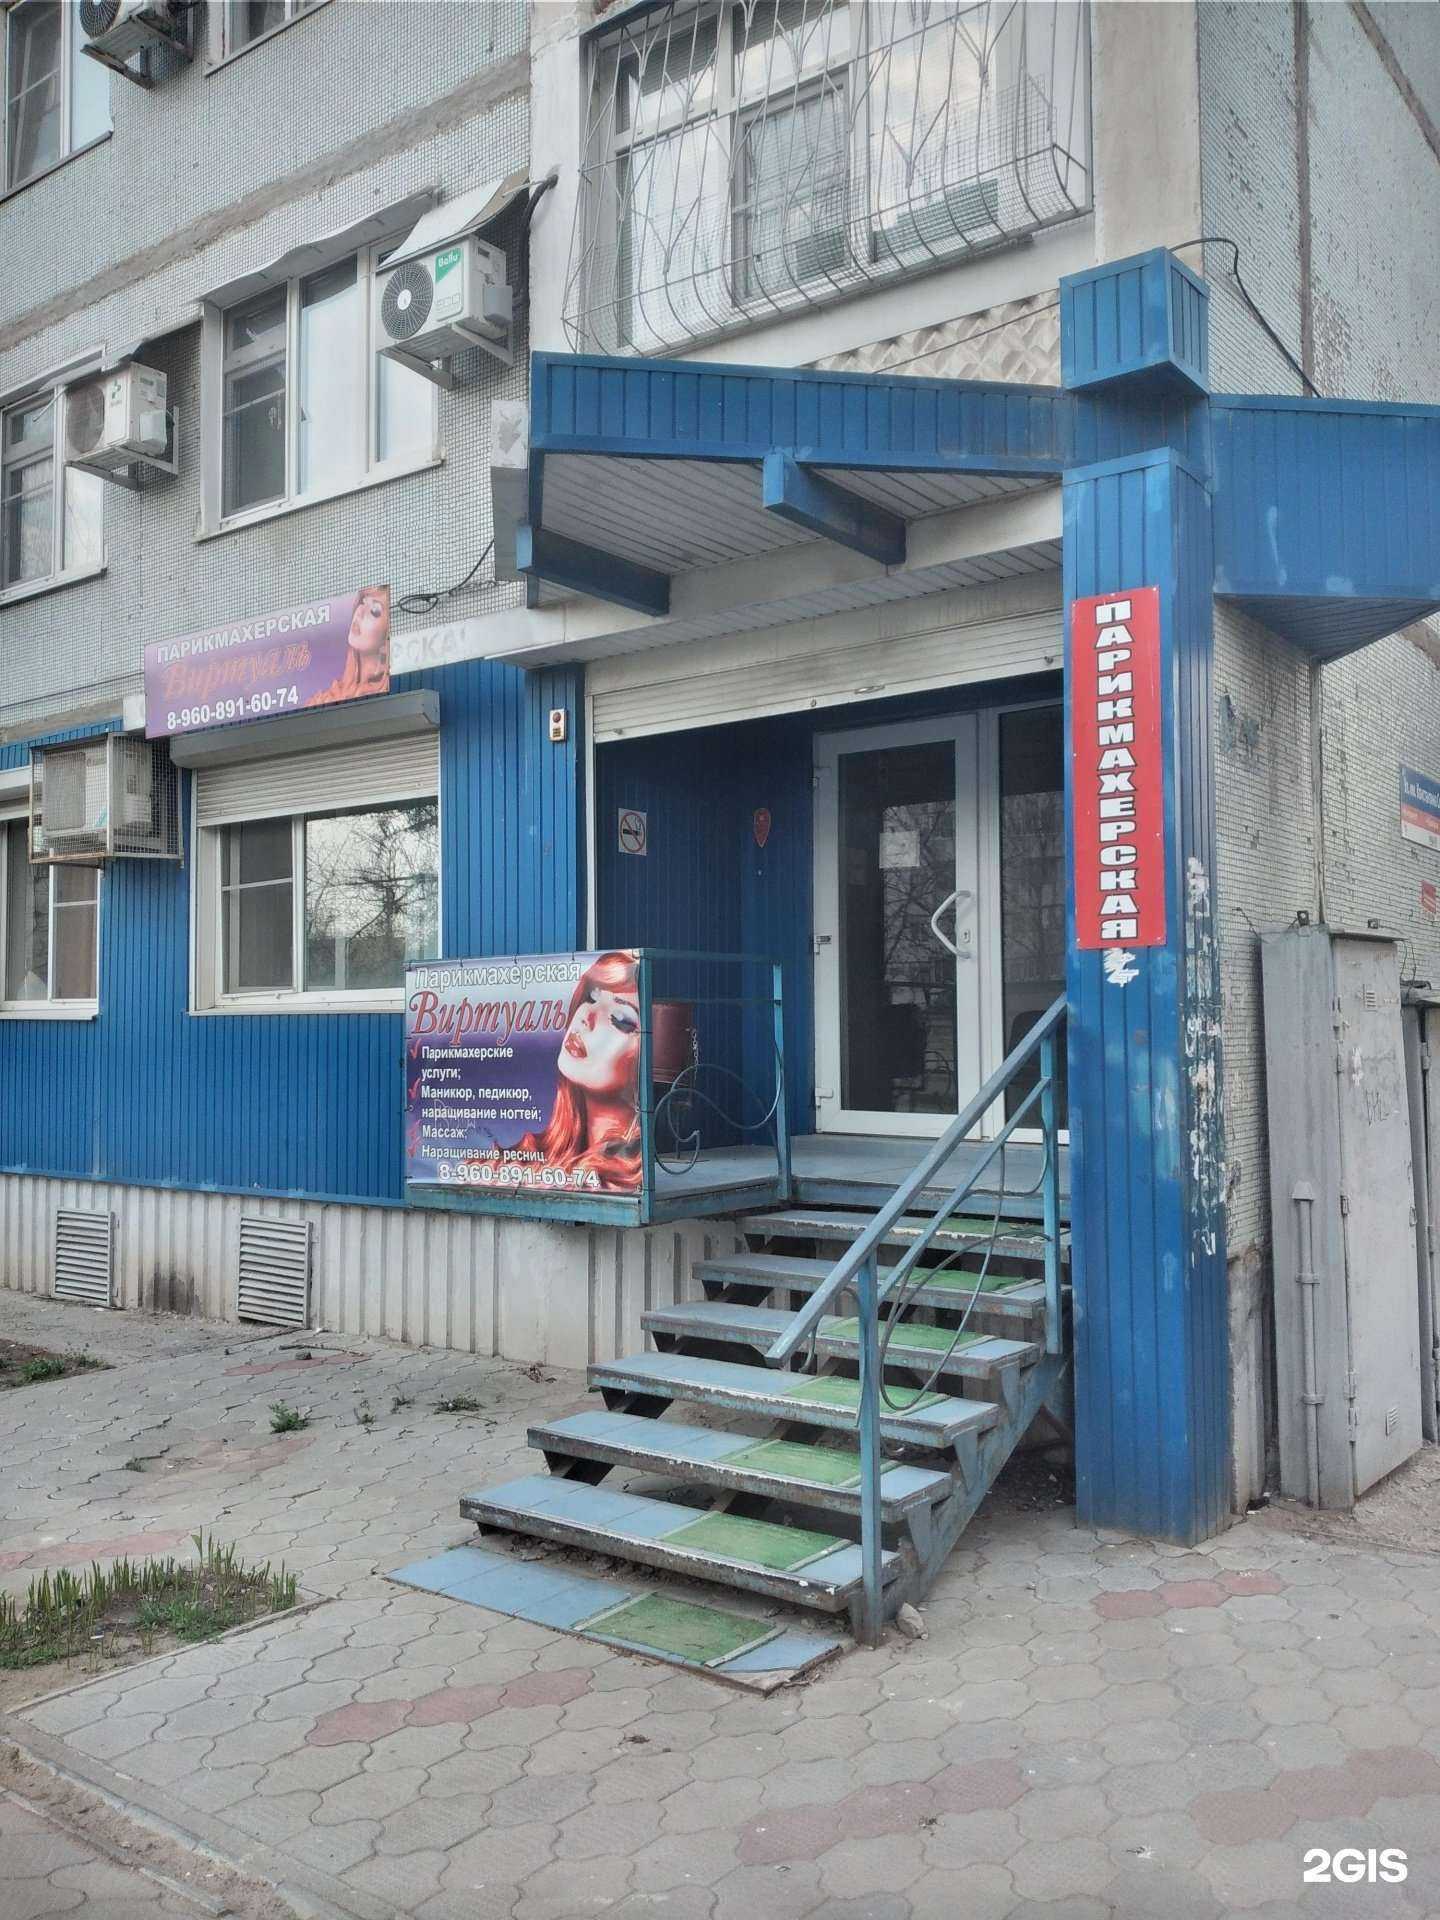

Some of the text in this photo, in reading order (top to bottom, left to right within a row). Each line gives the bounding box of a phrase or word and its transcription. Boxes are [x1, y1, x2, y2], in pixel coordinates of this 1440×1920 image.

[157, 604, 331, 664] ПАРИКМАХЕРСКАЯ
[167, 685, 299, 730] 8-960-891-60-74
[1094, 599, 1139, 940] ПАРИКМАХЕРСКАЯ
[415, 962, 582, 993] Парикмахерская
[408, 990, 570, 1047] Виртуаль
[421, 1046, 514, 1061] Парикмахерские
[421, 1067, 462, 1081] услуги;
[421, 1086, 532, 1101] Маникюр, педикюр,
[421, 1106, 497, 1121] наращивание
[500, 1105, 542, 1121] ногтей;
[421, 1145, 548, 1163] Наращивание ресниц.
[438, 1163, 600, 1187] 8-960-891-60-74
